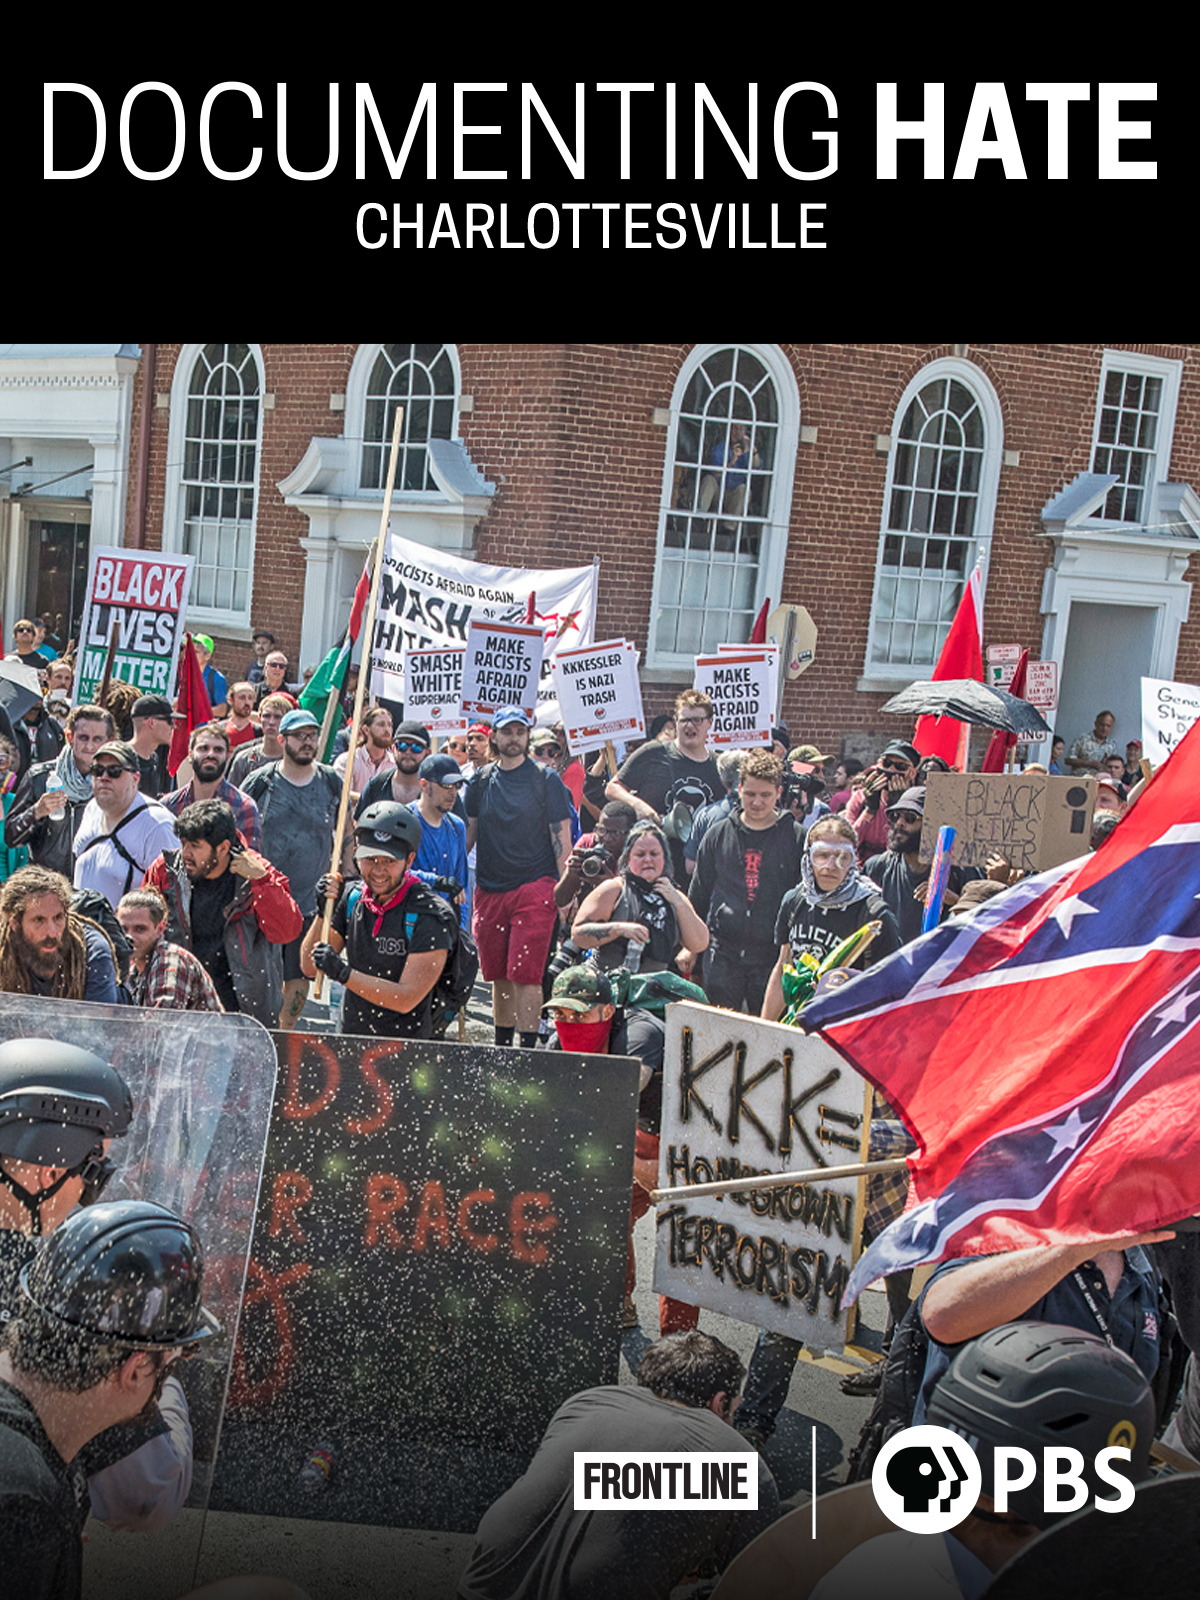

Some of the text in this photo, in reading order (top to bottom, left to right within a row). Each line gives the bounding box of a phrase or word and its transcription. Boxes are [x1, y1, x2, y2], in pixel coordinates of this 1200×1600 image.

[95, 558, 186, 608] BLACK
[436, 576, 475, 598] AFRAID
[380, 573, 472, 642] MASH
[88, 605, 175, 656] LIVES
[486, 636, 526, 655] MAKE
[410, 653, 463, 673] SMASH
[474, 651, 532, 672] RACISTS
[562, 653, 622, 675] KKKESSLER
[411, 673, 463, 693] WHITE
[475, 670, 528, 689] AFRAID
[575, 673, 615, 691] IS NAZI
[713, 668, 751, 684] MAKE
[1030, 672, 1053, 680] LOADING
[477, 686, 523, 705] AGAIN
[580, 690, 617, 707] TRASH
[705, 683, 760, 699] RACISTS
[712, 700, 759, 717] AFRAID
[713, 716, 756, 732] AGAIN
[965, 779, 1046, 820] BLACK
[973, 818, 1038, 843] LIVES
[363, 1173, 560, 1265] RACE
[656, 1203, 850, 1321] TERRORISM
